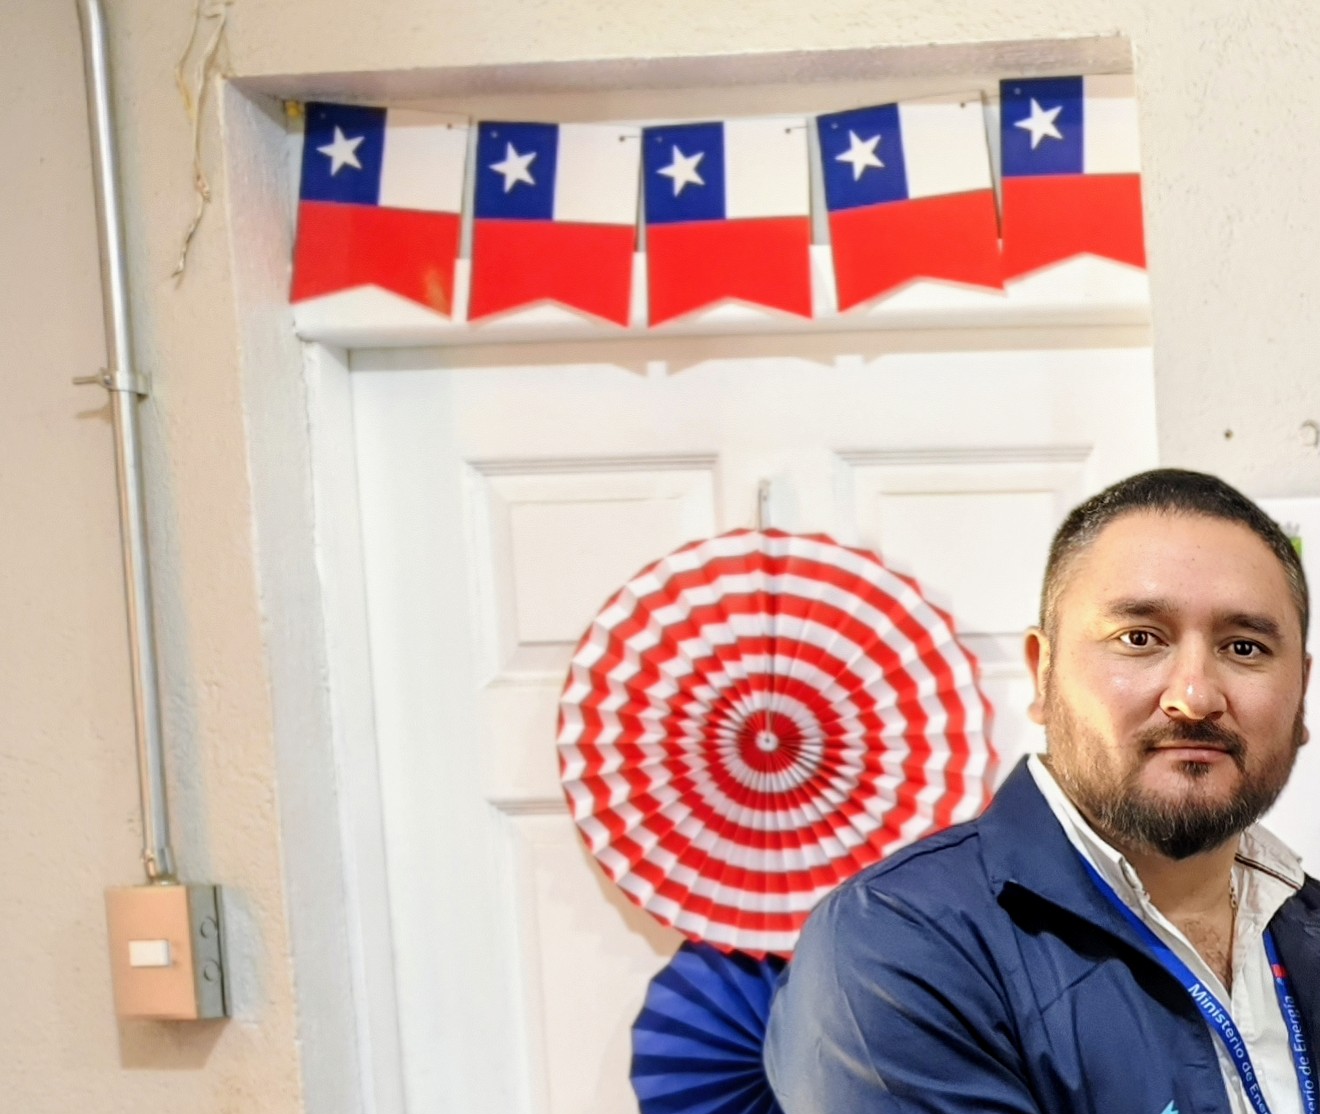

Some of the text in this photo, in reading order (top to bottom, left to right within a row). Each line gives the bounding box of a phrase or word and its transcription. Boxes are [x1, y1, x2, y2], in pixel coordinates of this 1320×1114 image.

[1188, 983, 1245, 1059] Ministerio
[1242, 1061, 1253, 1082] de
[1298, 1056, 1311, 1076] de
